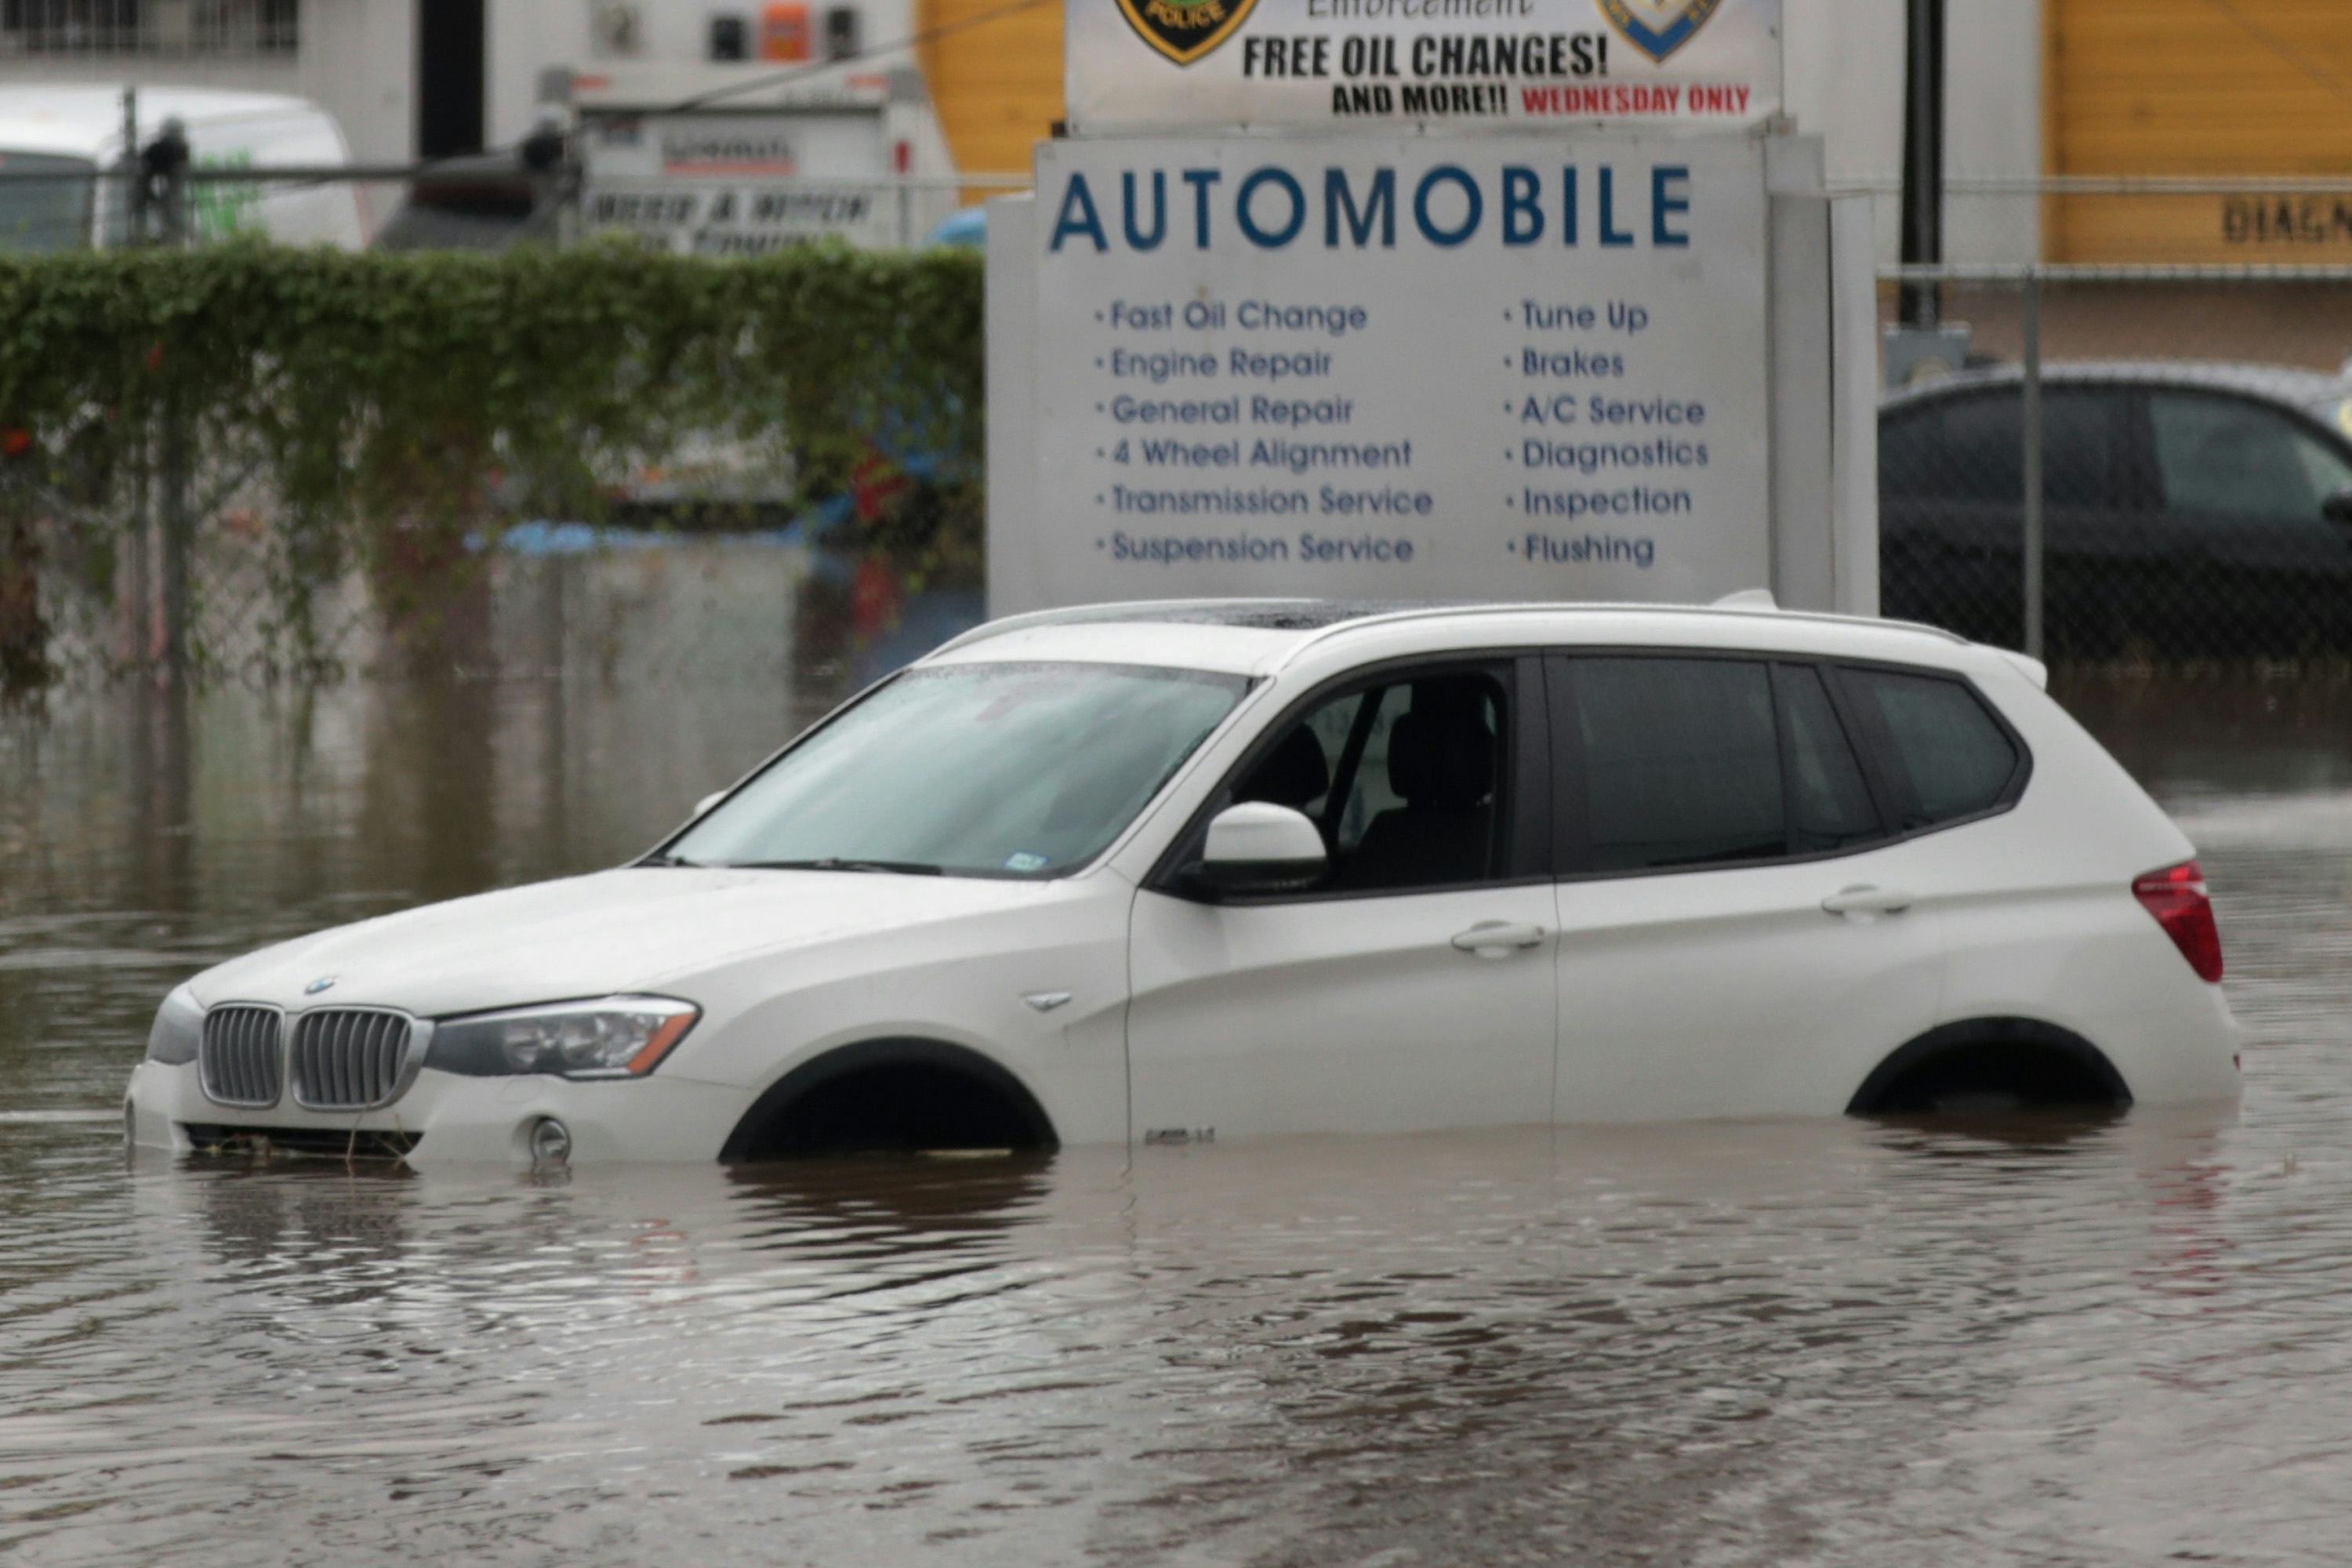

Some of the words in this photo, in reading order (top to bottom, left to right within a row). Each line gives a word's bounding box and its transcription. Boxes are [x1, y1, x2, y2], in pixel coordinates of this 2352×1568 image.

[1145, 1, 1225, 29] POLICE
[1243, 36, 1329, 77] FREE
[1341, 36, 1399, 77] OIL
[1410, 34, 1608, 78] CHANGES!
[1331, 84, 1394, 115] AND
[1400, 83, 1508, 114] MORE!!
[1521, 86, 1679, 113] WEDNESDAY
[1687, 86, 1749, 111] ONLY
[1048, 164, 1690, 252] AUTOMOBILE
[1110, 301, 1174, 330] Fast
[1183, 301, 1226, 330] Oil
[1236, 301, 1368, 337] Change
[1522, 300, 1596, 329] Tune
[1606, 301, 1649, 336] Up
[1111, 348, 1219, 384] Engine
[1228, 349, 1332, 382] Repair
[1521, 349, 1624, 378] Brakes
[1111, 394, 1240, 424] General
[1250, 395, 1353, 429] Repair
[1520, 394, 1576, 425] A/C
[1588, 395, 1706, 425] Service
[1113, 439, 1130, 467] 4
[1141, 439, 1240, 468] Wheel
[1248, 438, 1412, 474] Alignment
[1522, 438, 1709, 474] Diagnostics
[1112, 485, 1309, 515] Transmission
[1318, 485, 1435, 516] Service
[1523, 486, 1692, 521] Inspection
[1112, 532, 1289, 566] Suspension
[1298, 533, 1415, 564] Service
[1525, 532, 1655, 568] Flushing
